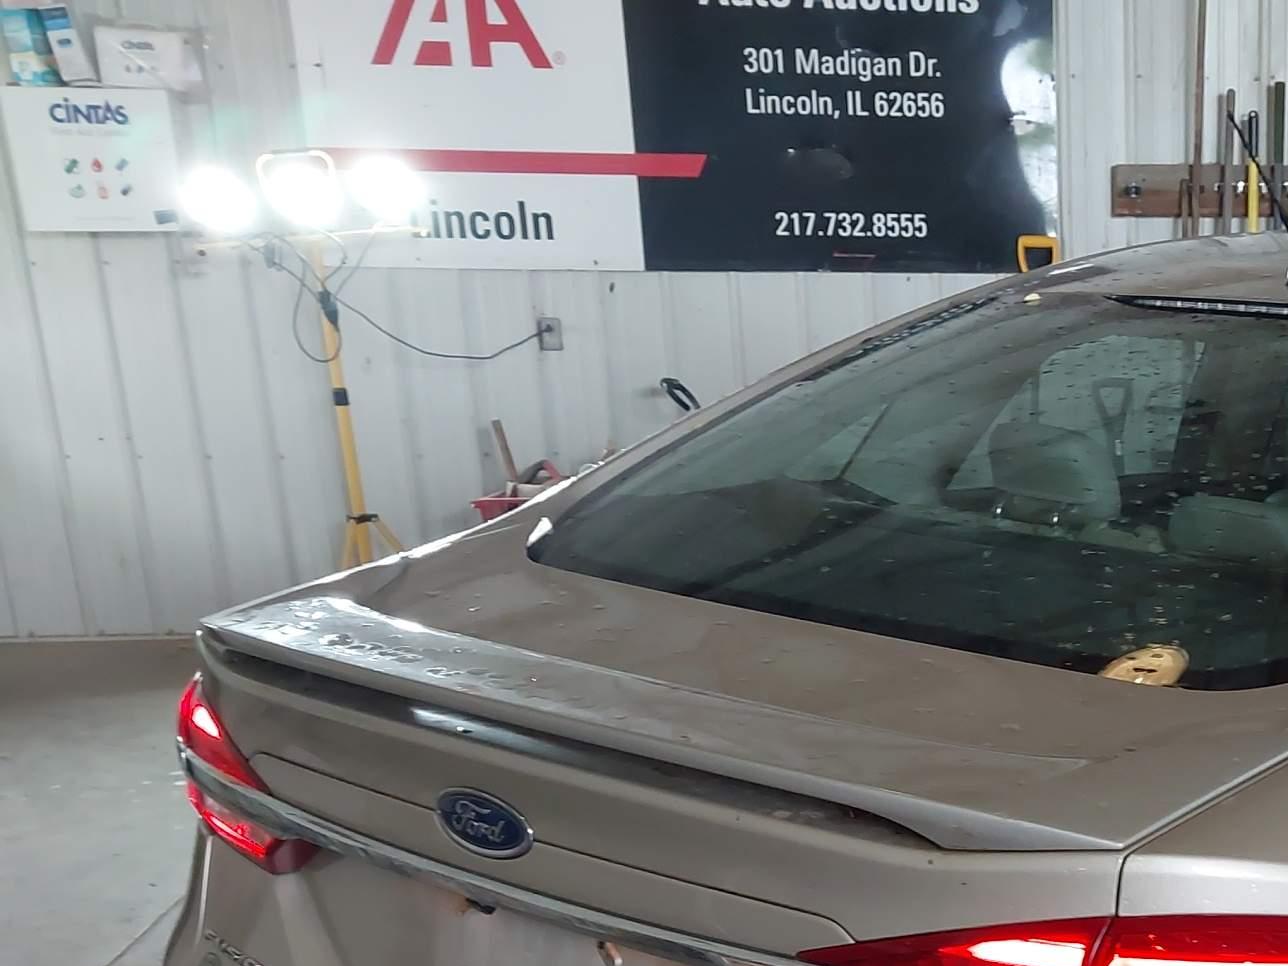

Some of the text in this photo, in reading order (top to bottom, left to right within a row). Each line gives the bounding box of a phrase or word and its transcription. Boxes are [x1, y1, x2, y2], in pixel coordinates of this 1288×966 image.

[743, 47, 941, 82] 301 Madigan Dr.
[745, 88, 945, 120] Lincoln, IL 62656
[774, 211, 928, 238] 217.732.8555
[452, 799, 505, 843] Ford
